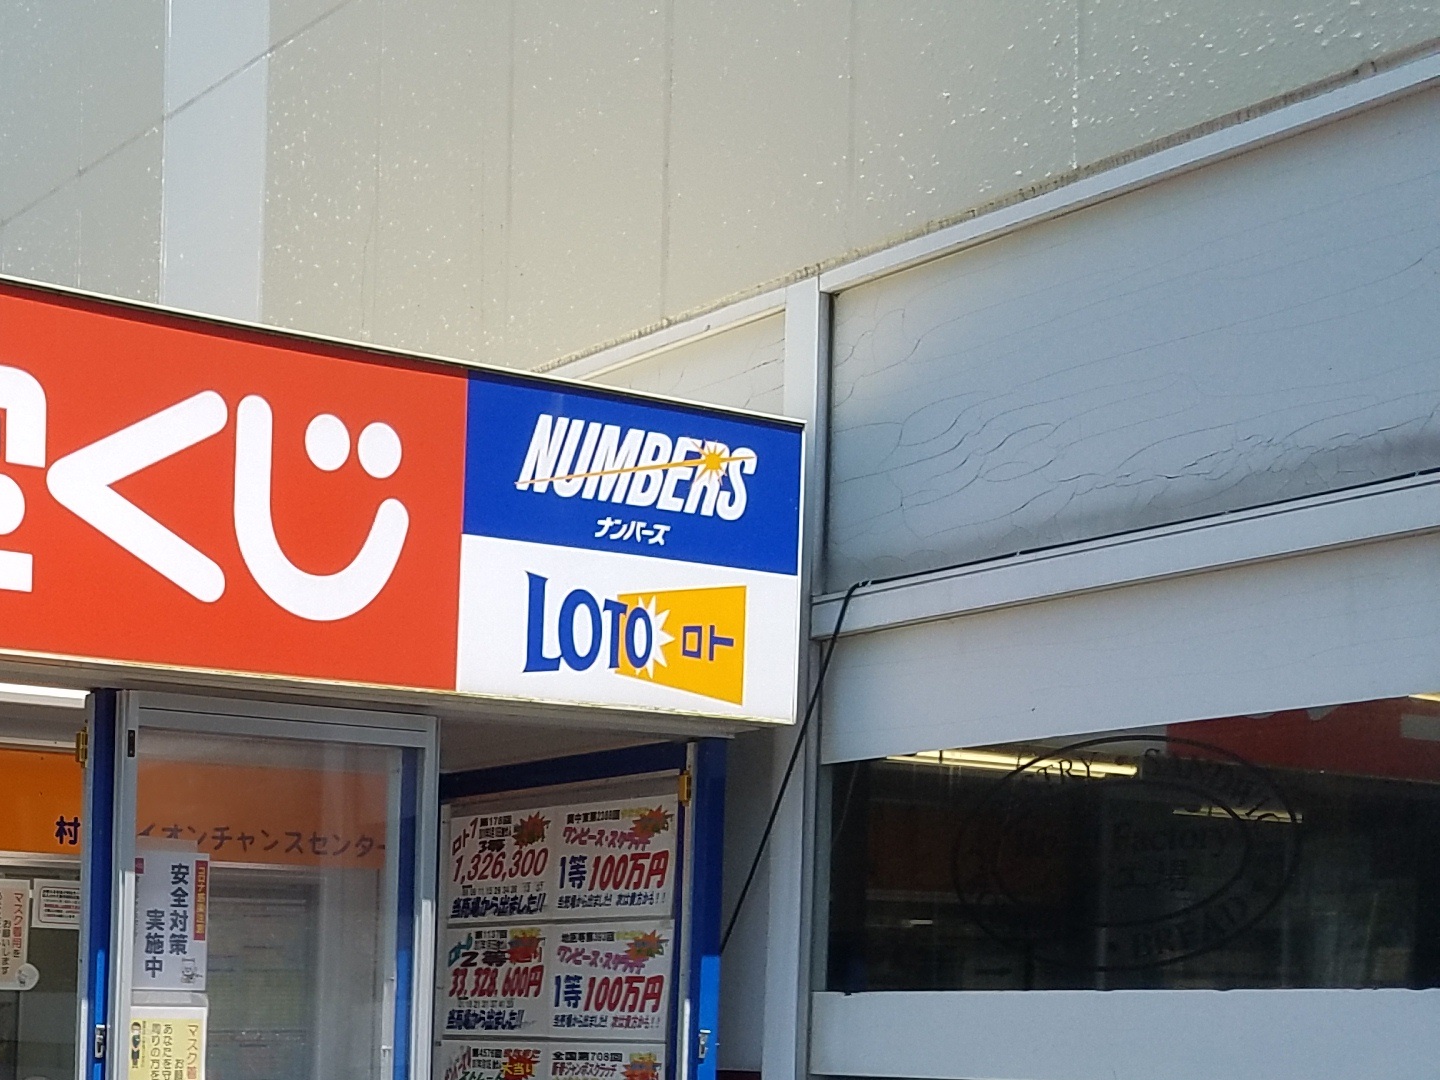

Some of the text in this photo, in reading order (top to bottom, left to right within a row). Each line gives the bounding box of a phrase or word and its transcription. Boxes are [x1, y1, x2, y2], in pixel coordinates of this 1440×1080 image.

[517, 413, 758, 521] NUMBERS
[594, 515, 671, 547] ナンバーズ
[523, 571, 653, 673] LOTO
[681, 623, 736, 664] ロト
[453, 847, 549, 885] 1,326,300
[559, 850, 670, 891] 1等 100万円
[169, 862, 191, 956] 安全対策
[144, 908, 166, 979] 実施中
[554, 975, 664, 1013] 1等 100万円
